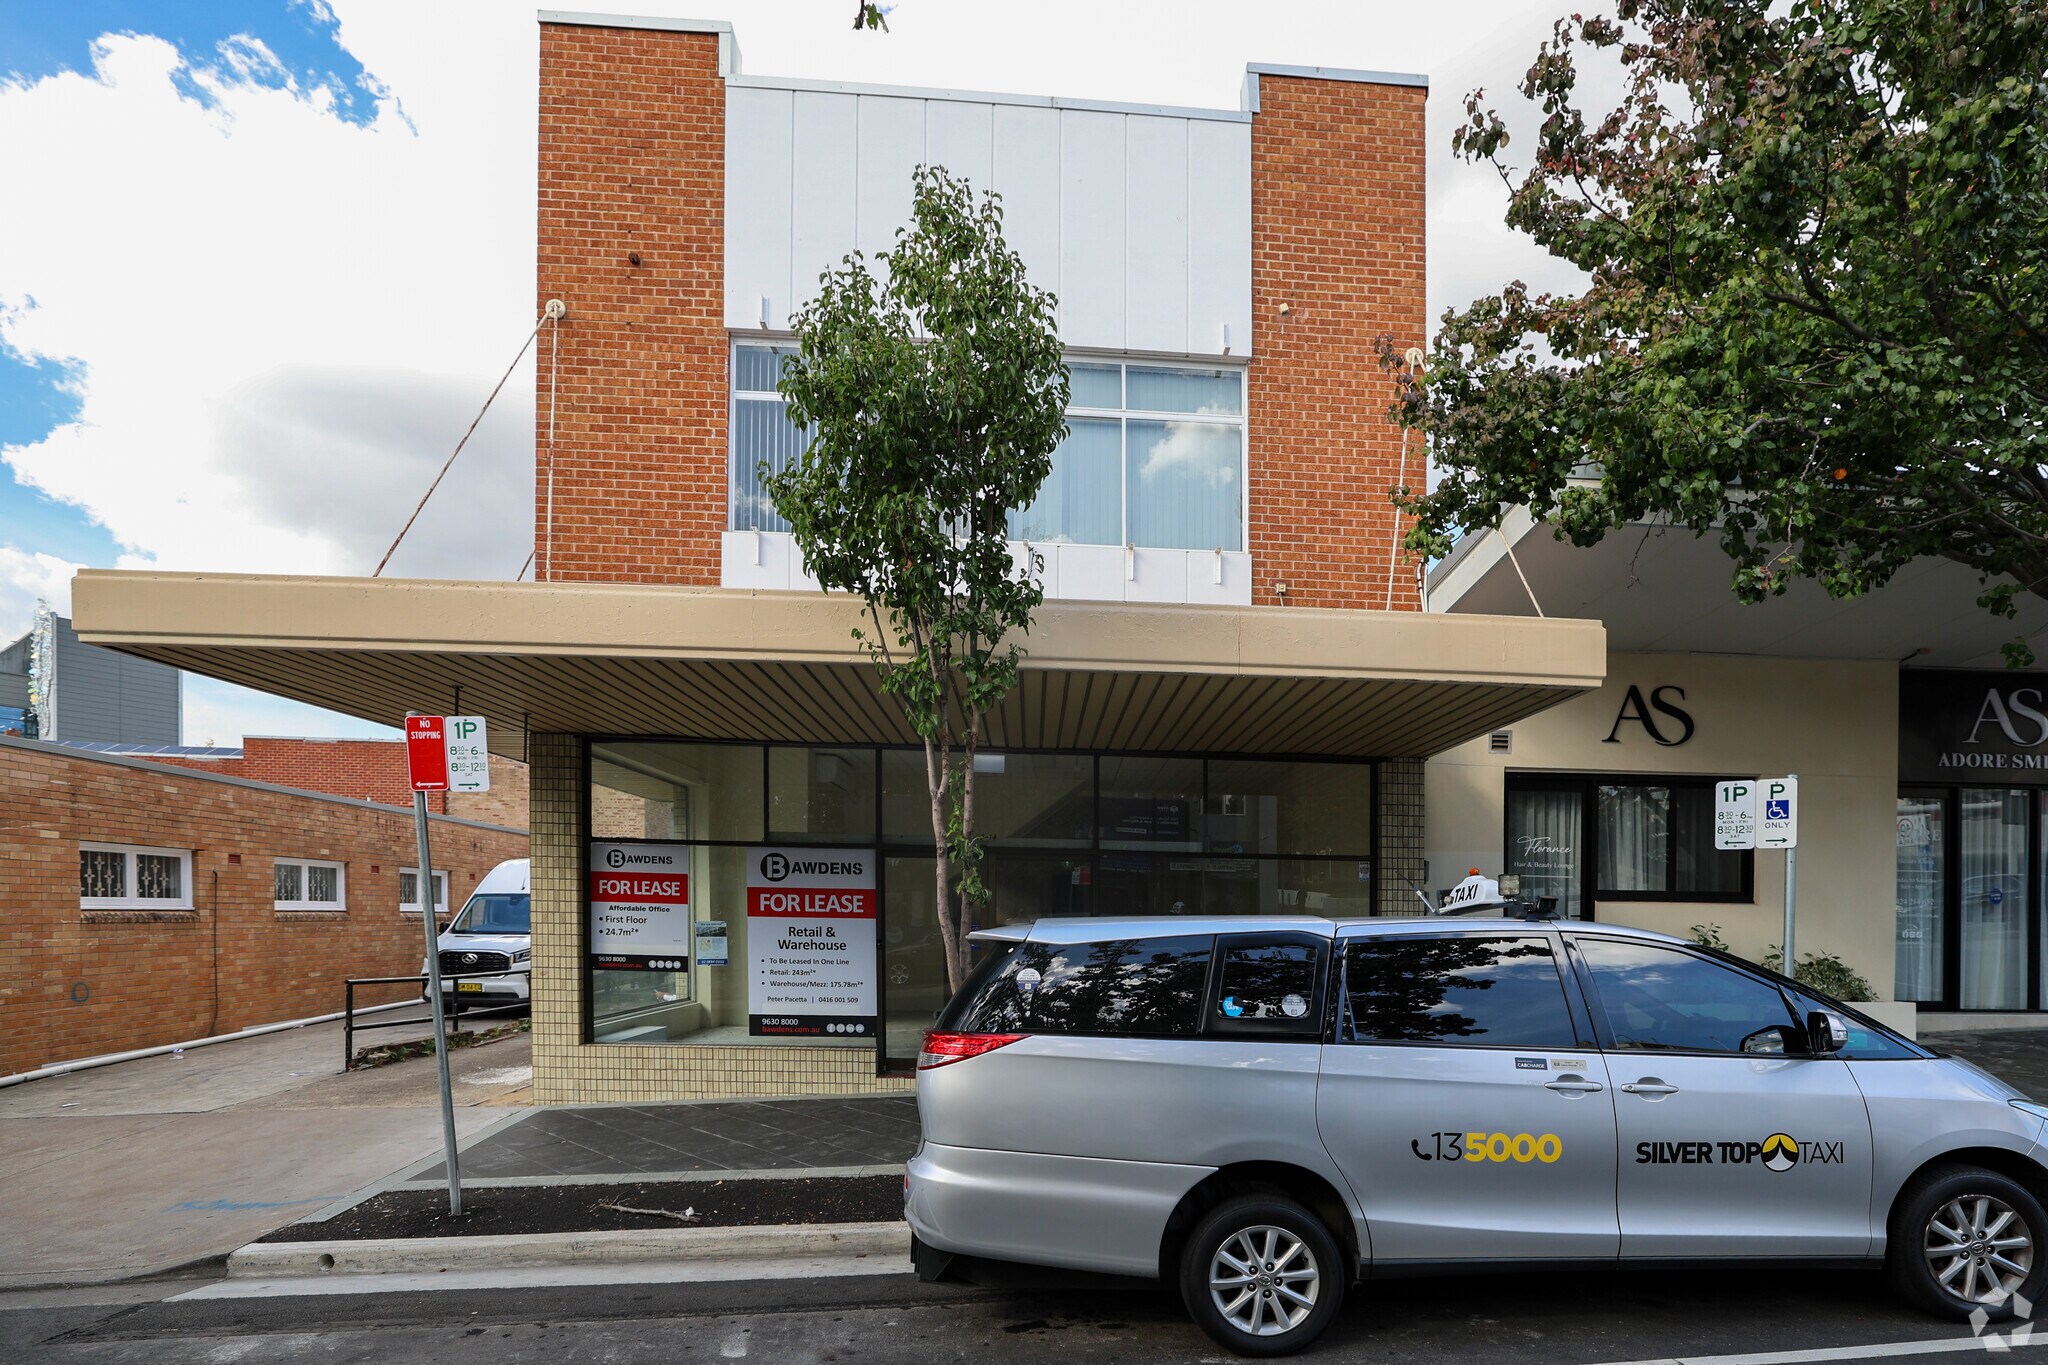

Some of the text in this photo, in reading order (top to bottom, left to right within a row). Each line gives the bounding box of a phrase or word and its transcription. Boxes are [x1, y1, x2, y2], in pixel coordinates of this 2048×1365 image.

[1602, 684, 1695, 747] AS
[1962, 688, 2048, 747] AS
[419, 720, 430, 728] NO
[454, 721, 477, 739] 1P
[410, 731, 441, 739] STOPPING
[1938, 752, 2008, 768] ADORE
[1723, 786, 1748, 802] 1P
[1770, 784, 1785, 799] P
[1740, 811, 1747, 819] 6
[1517, 835, 1572, 857] Florance
[607, 849, 673, 868] BAWDENS
[1554, 862, 1574, 870] Lounge
[760, 853, 863, 881] BAWDENS
[599, 880, 680, 896] FOR LEASE
[1453, 884, 1479, 904] TAXI
[760, 893, 864, 913] FOR LEASE
[605, 915, 647, 924] First Floor
[788, 926, 836, 937] Retail &
[778, 939, 847, 950] Warehouse
[1635, 1141, 1844, 1164] SILVER TOP TAXI
